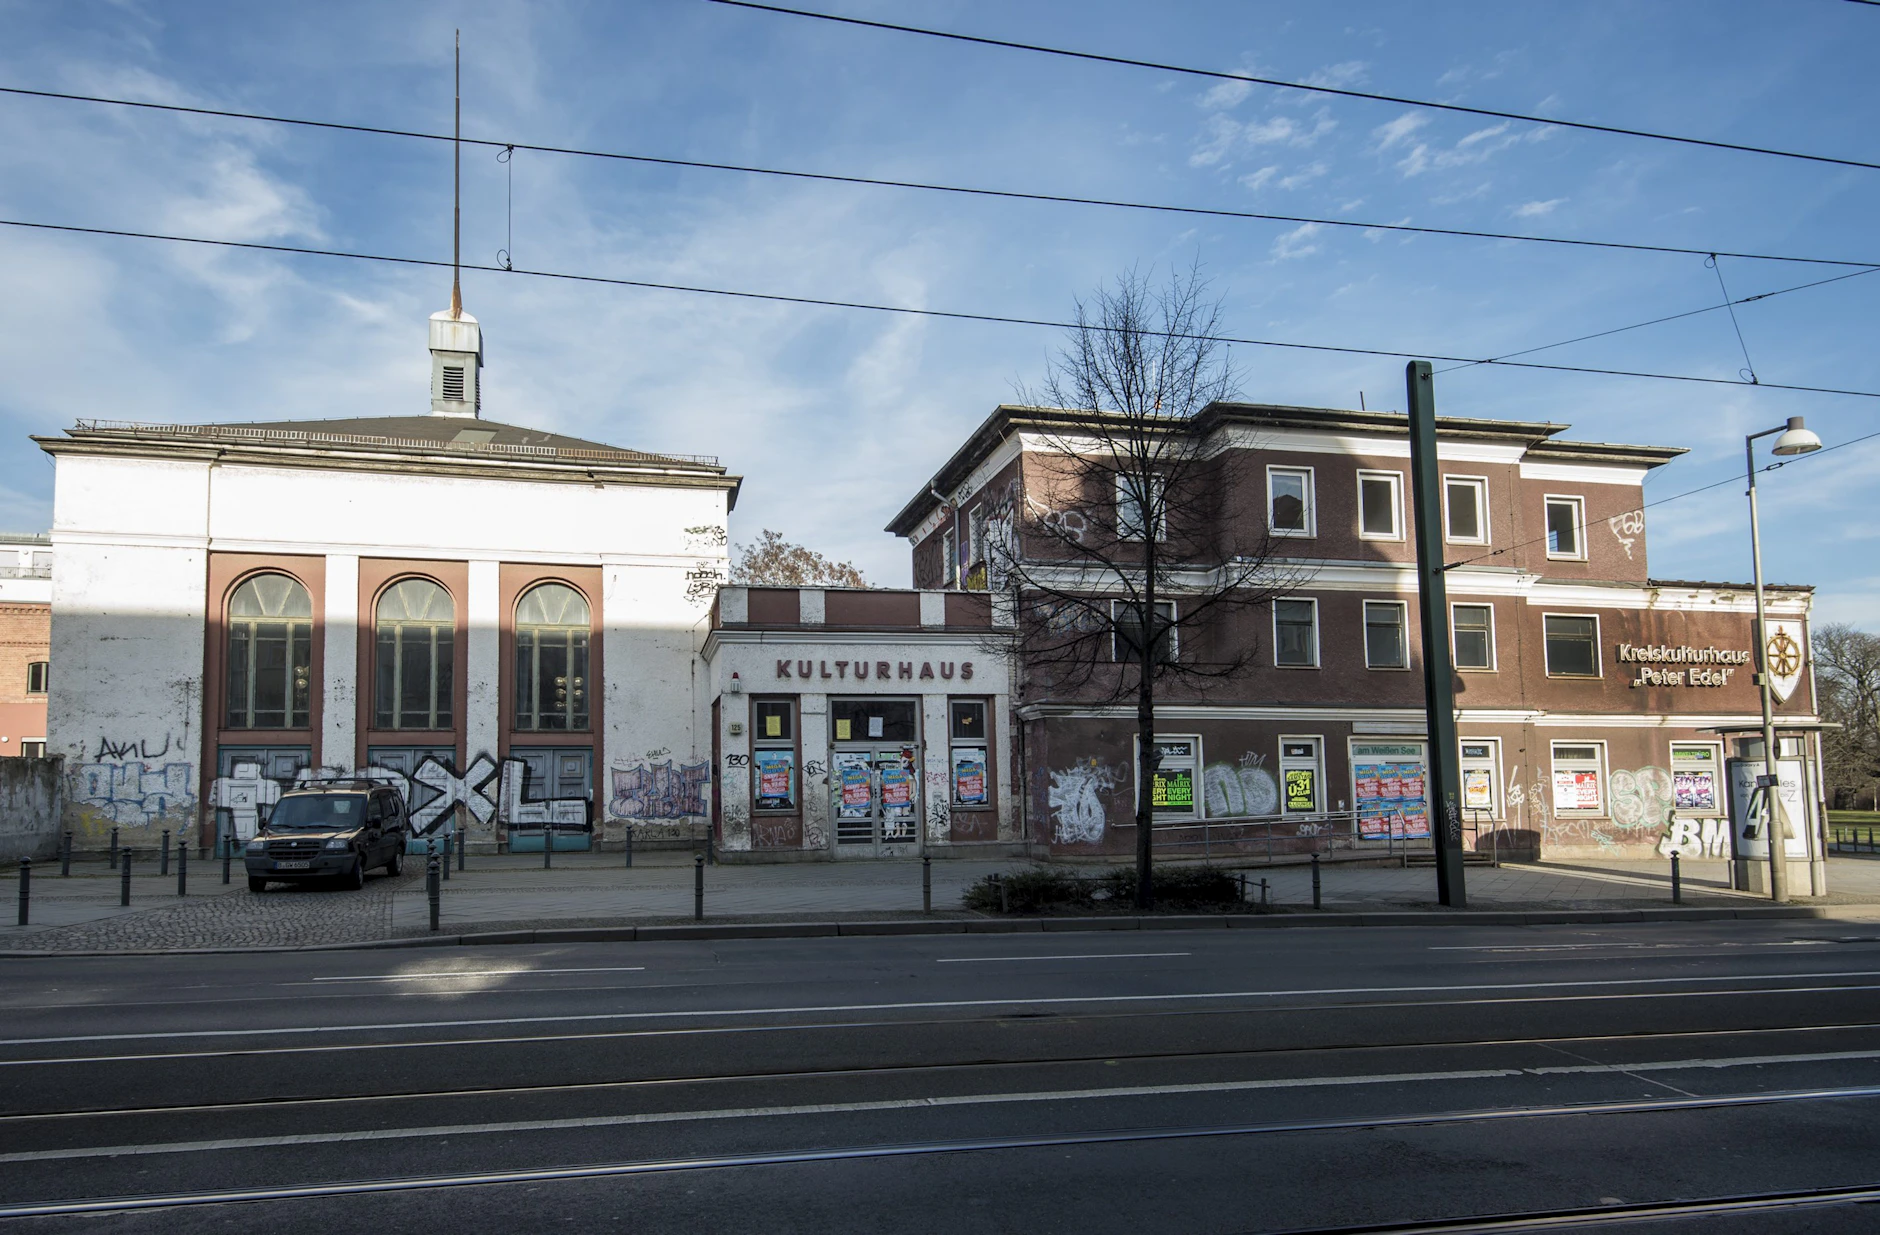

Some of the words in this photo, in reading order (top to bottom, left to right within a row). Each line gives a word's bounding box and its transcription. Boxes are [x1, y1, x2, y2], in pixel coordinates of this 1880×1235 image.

[1616, 643, 1751, 665] Kreiskulturhaus
[776, 659, 974, 680] KULTURHAUS
[1371, 746, 1399, 754] Weißen
[1401, 747, 1416, 755] See
[725, 753, 750, 769] 130
